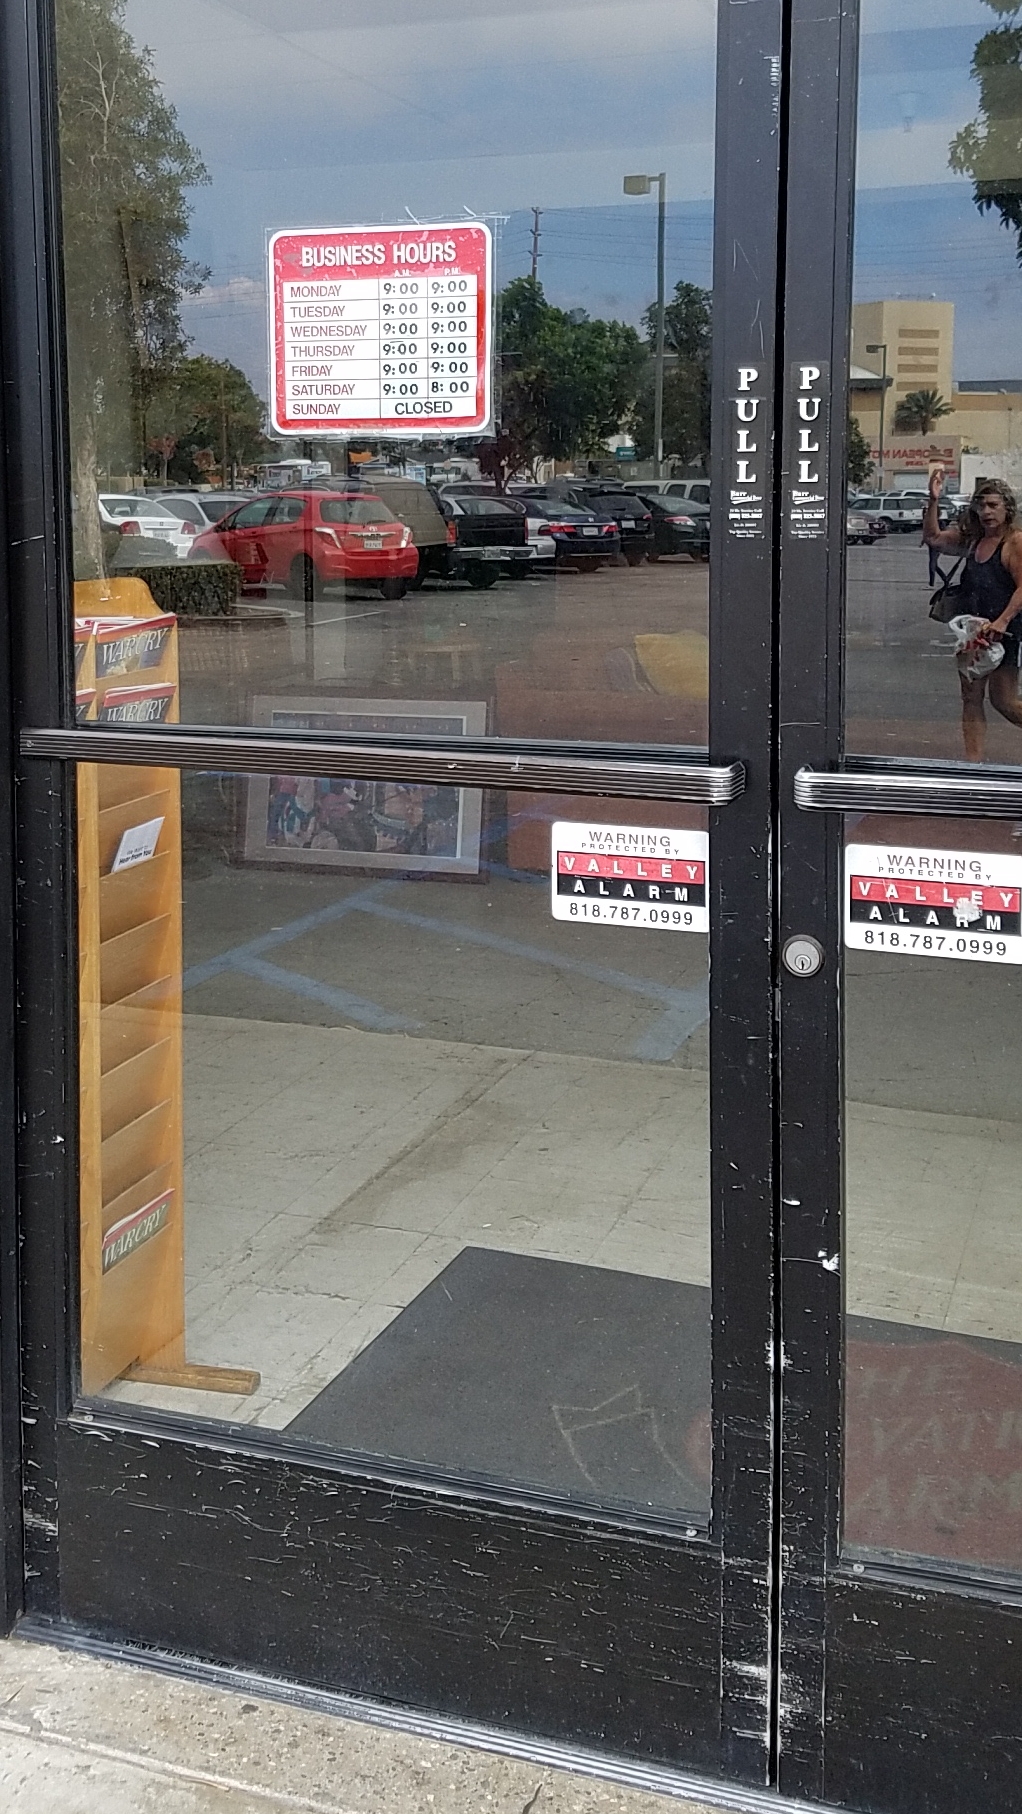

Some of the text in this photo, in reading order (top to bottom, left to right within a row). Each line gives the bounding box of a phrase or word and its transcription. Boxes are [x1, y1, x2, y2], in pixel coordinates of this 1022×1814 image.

[301, 241, 457, 268] BUSINESS HOURS
[394, 268, 412, 278] A.M.
[290, 279, 468, 298] MONDAY 9:00 9:00
[290, 300, 467, 318] TUESDAY 9:00 9:00
[290, 320, 468, 337] WEDNESDAY 9:00 9:00
[291, 341, 467, 358] THURSDAY 9:00 9:00
[291, 361, 469, 377] FRIDAY 9:00 9:00
[291, 381, 470, 396] SATURDAY 9:00 8:00
[292, 400, 453, 416] SUNDAY CLOSED
[735, 368, 760, 483] PULL
[797, 366, 821, 483] PULL
[588, 830, 671, 847] WARNING
[581, 842, 680, 856] PROTECTED BY
[564, 856, 698, 880] VALLEY
[887, 854, 982, 872] WARNING
[878, 866, 992, 881] PROTECTED BY
[573, 879, 688, 902] ALARM
[858, 881, 1013, 908] VALLEY
[569, 902, 693, 925] 818.787.0999
[869, 905, 1002, 931] ALARM
[864, 930, 1007, 956] 818.787.0999
